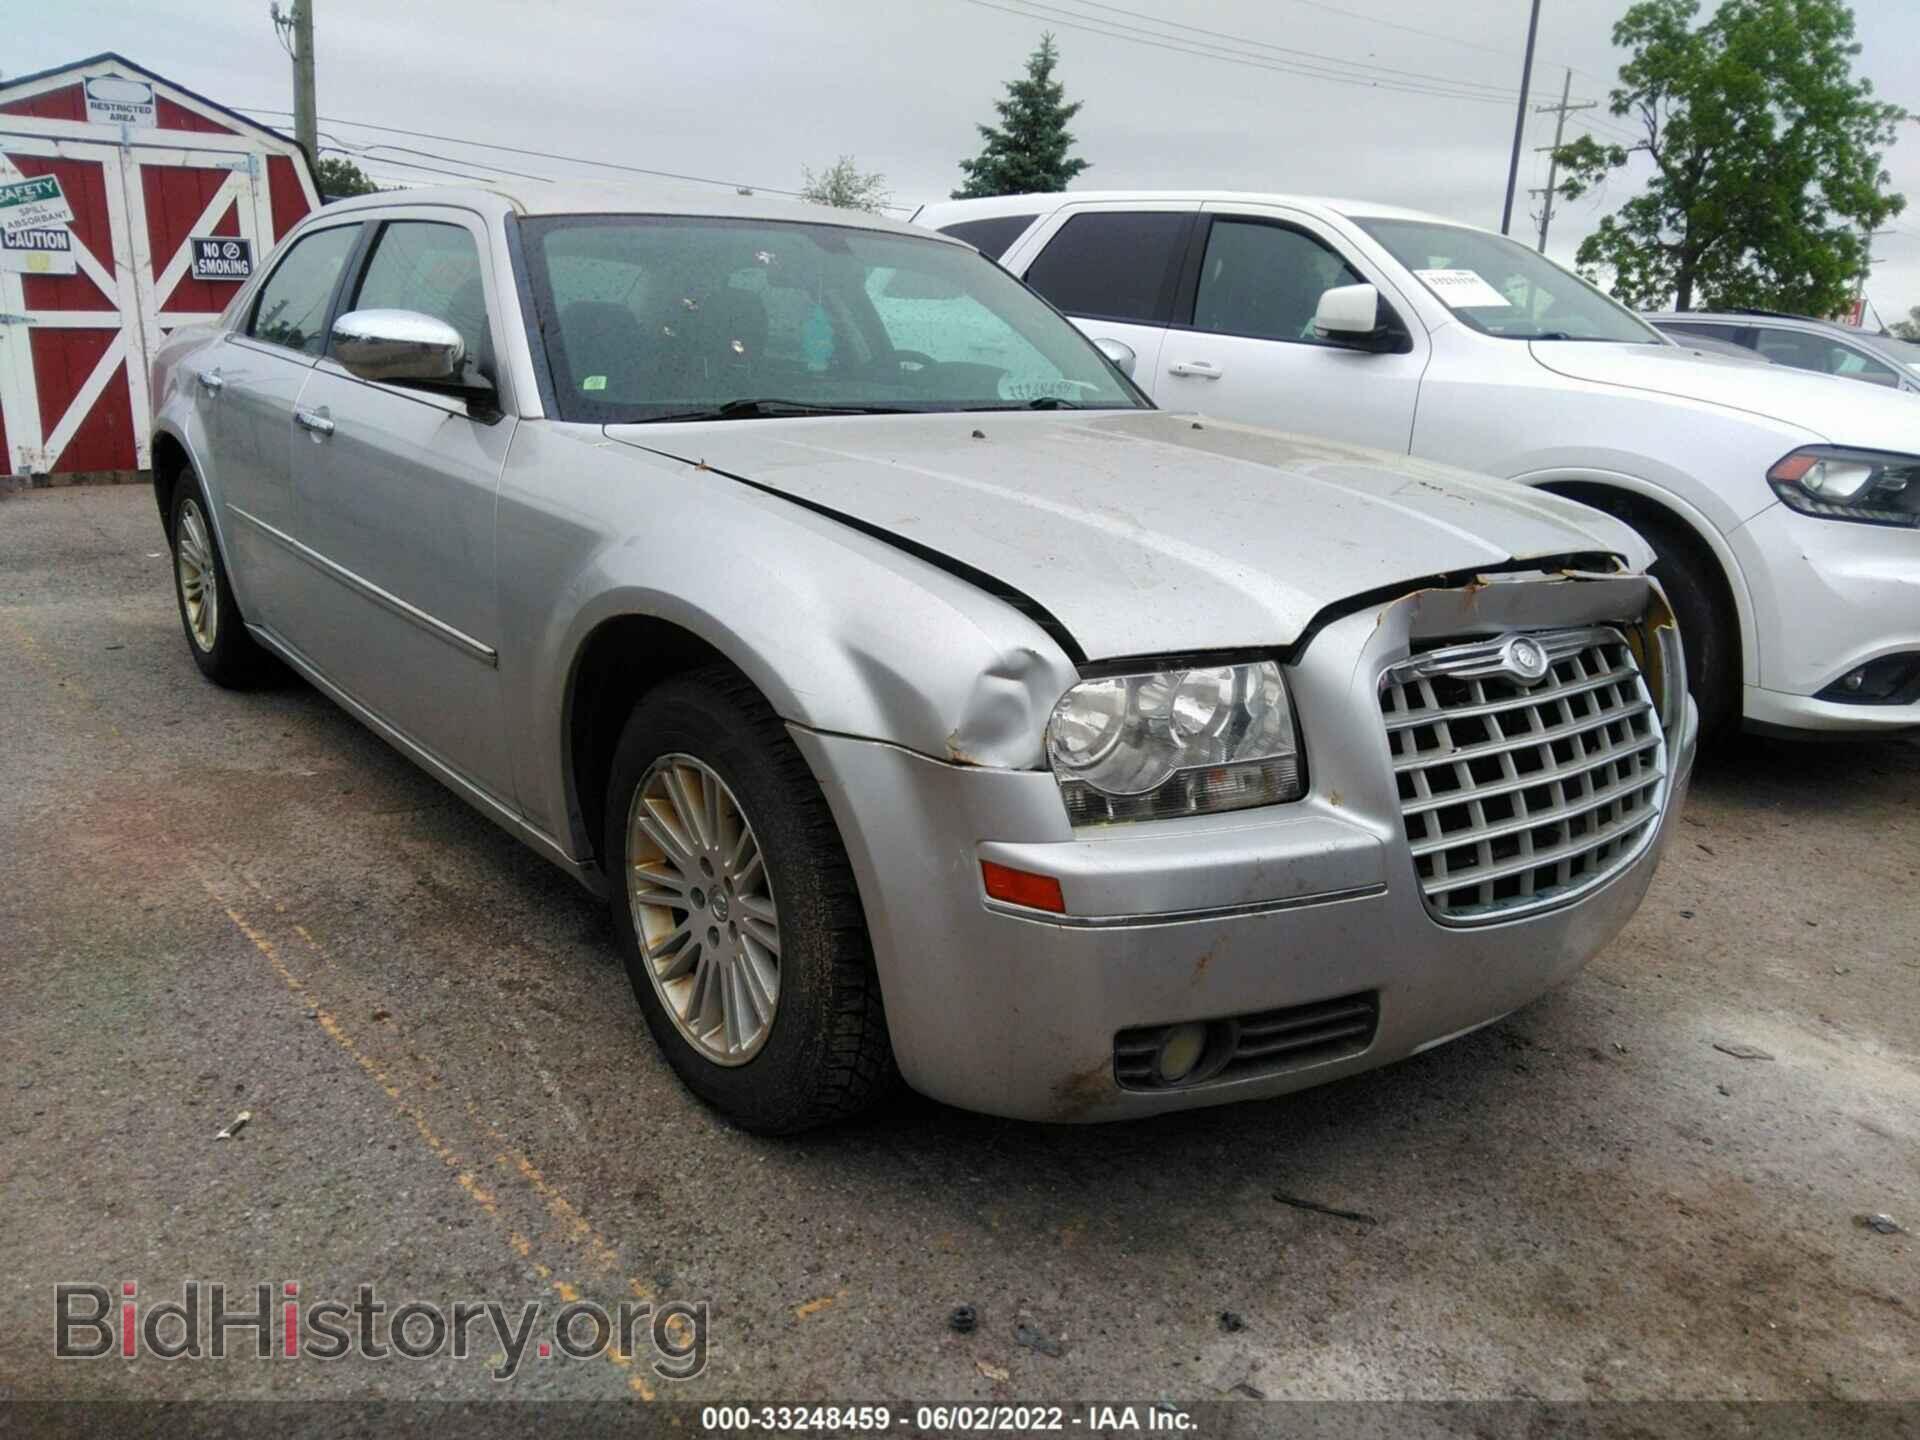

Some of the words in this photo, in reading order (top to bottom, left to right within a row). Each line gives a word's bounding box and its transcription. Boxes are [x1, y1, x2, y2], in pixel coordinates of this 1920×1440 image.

[90, 102, 152, 114] RESTRICTED
[110, 113, 136, 122] AREA
[0, 180, 53, 202] SAFETY
[18, 204, 48, 216] SPILL
[7, 210, 67, 229] ABSORBANT
[5, 230, 67, 249] CAUTION
[203, 242, 219, 258] NO
[199, 259, 249, 274] SMOKING
